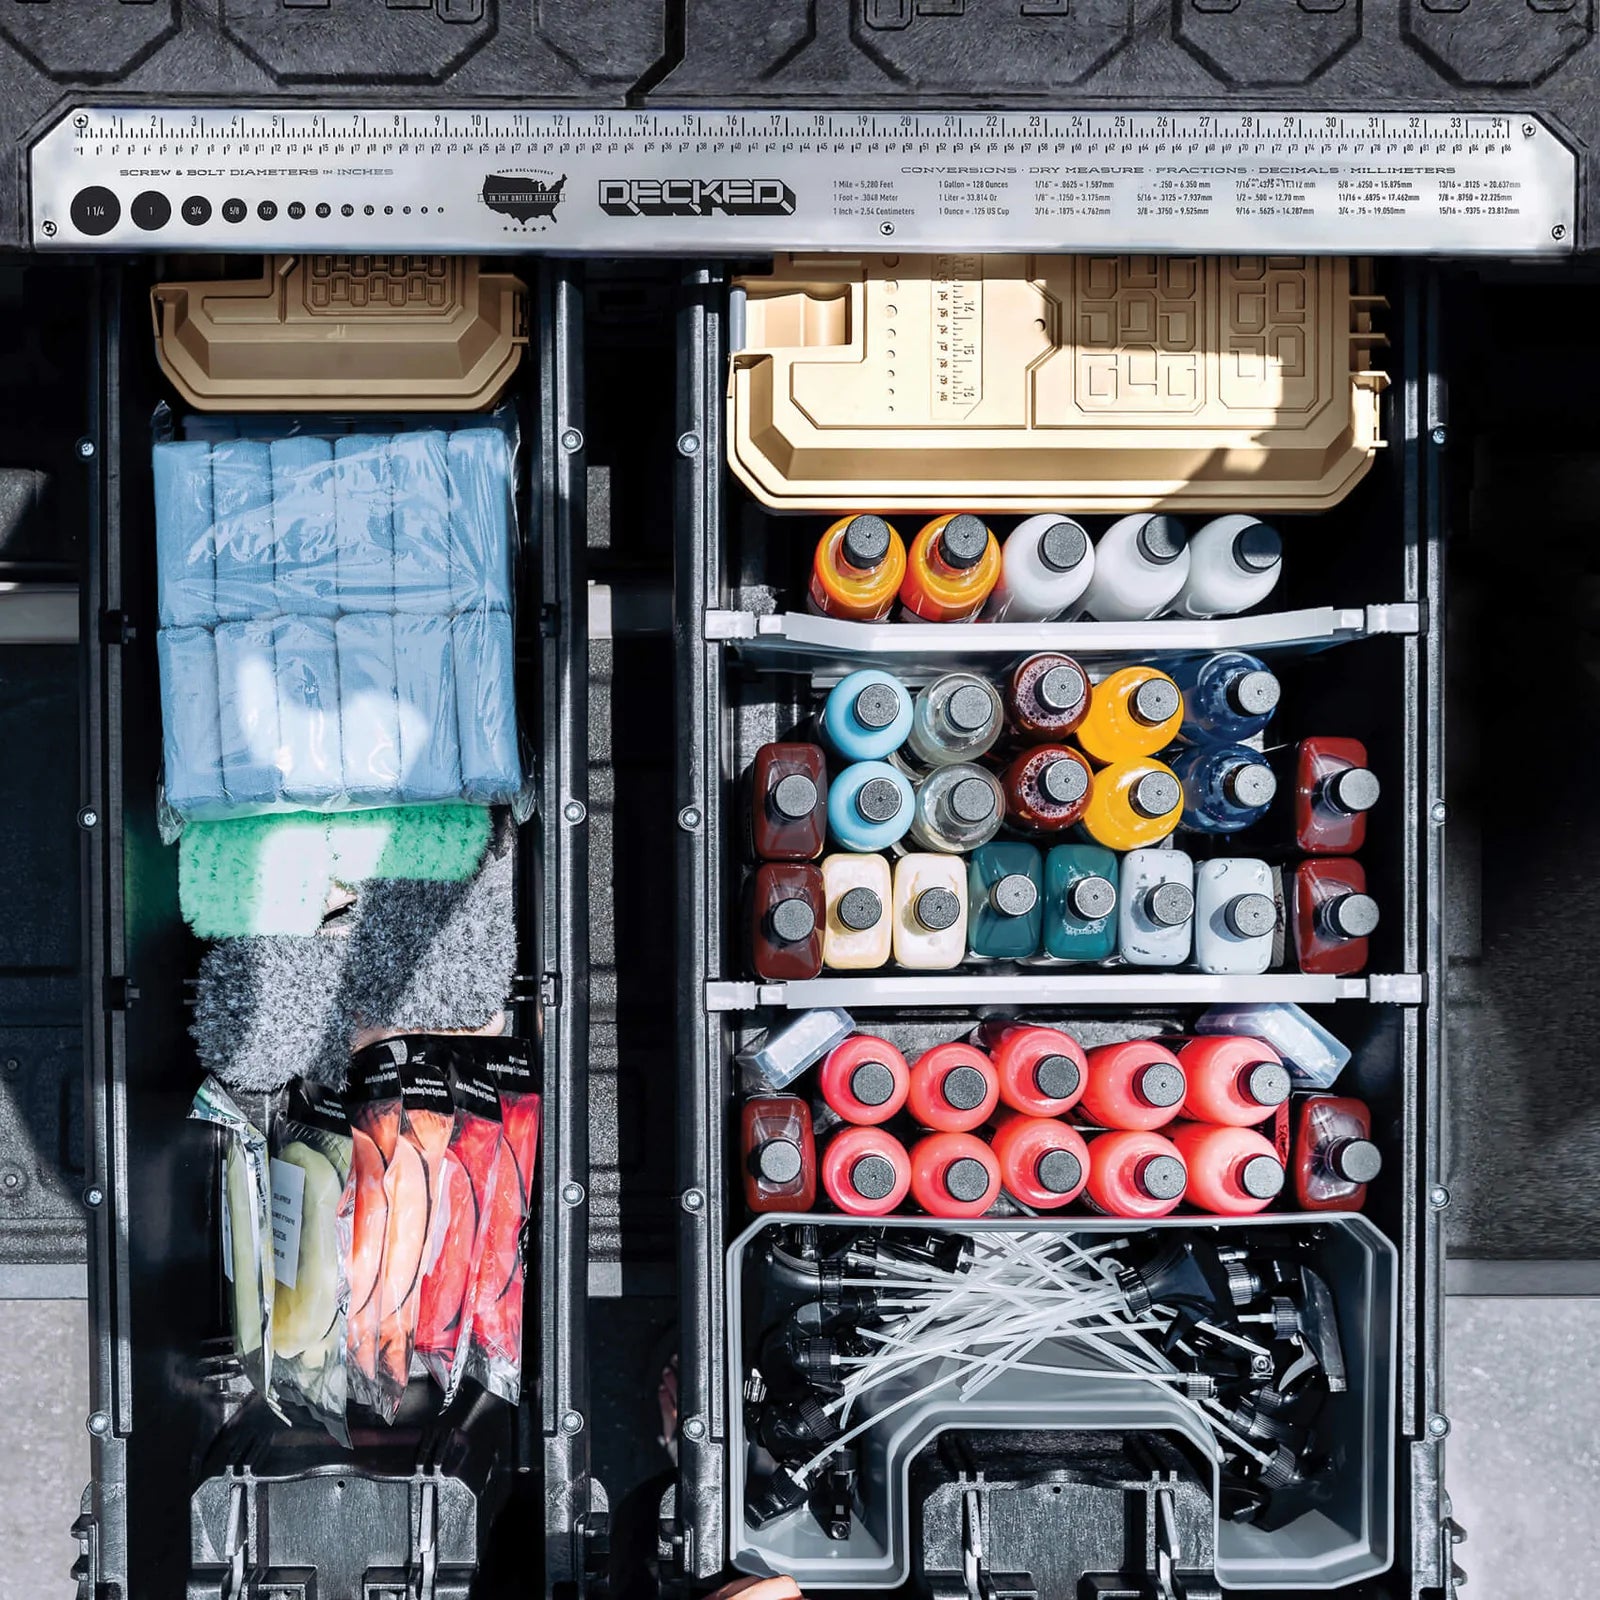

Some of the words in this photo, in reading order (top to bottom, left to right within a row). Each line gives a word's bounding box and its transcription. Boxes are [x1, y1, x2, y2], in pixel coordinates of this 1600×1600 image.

[112, 115, 116, 126] 1
[151, 115, 157, 126] 2
[191, 115, 197, 126] 3
[231, 115, 238, 126] 4
[272, 115, 278, 126] 5
[313, 115, 318, 126] 6
[353, 115, 359, 126] 7
[394, 115, 400, 126] 8
[434, 115, 440, 126] 9
[471, 115, 482, 126] 10
[513, 115, 522, 126] 11
[552, 115, 563, 126] 12
[594, 115, 604, 126] 13
[682, 116, 694, 126] 15
[726, 116, 737, 126] 16
[770, 116, 781, 127] 17
[814, 116, 824, 127] 18
[858, 116, 868, 127] 19
[900, 116, 912, 127] 20
[944, 116, 954, 127] 21
[986, 116, 998, 127] 22
[1029, 116, 1040, 127] 23
[1072, 116, 1082, 127] 24
[1114, 116, 1126, 127] 25
[1156, 116, 1168, 127] 26
[1199, 116, 1211, 127] 27
[1241, 116, 1252, 127] 28
[1283, 116, 1294, 127] 29
[1325, 117, 1336, 128] 30
[1368, 117, 1378, 128] 31
[1409, 117, 1420, 128] 32
[1450, 117, 1462, 128] 33
[1492, 117, 1502, 128] 34
[833, 180, 836, 188] 1
[839, 180, 853, 188] Mile
[879, 180, 894, 188] Feet
[939, 180, 942, 188] 1
[944, 180, 964, 188] Gallon
[972, 180, 983, 188] 128
[985, 180, 1008, 188] Ounces
[1338, 180, 1349, 188] 5/8
[1439, 180, 1456, 188] 13/16
[599, 180, 796, 216] DECKED
[86, 207, 90, 216] 1
[93, 207, 104, 216] 1/4
[150, 207, 153, 215] 1
[191, 207, 202, 215] 3/4
[229, 206, 239, 215] 5/8
[263, 206, 272, 215] 1/2
[997, 207, 1010, 216] Cup
